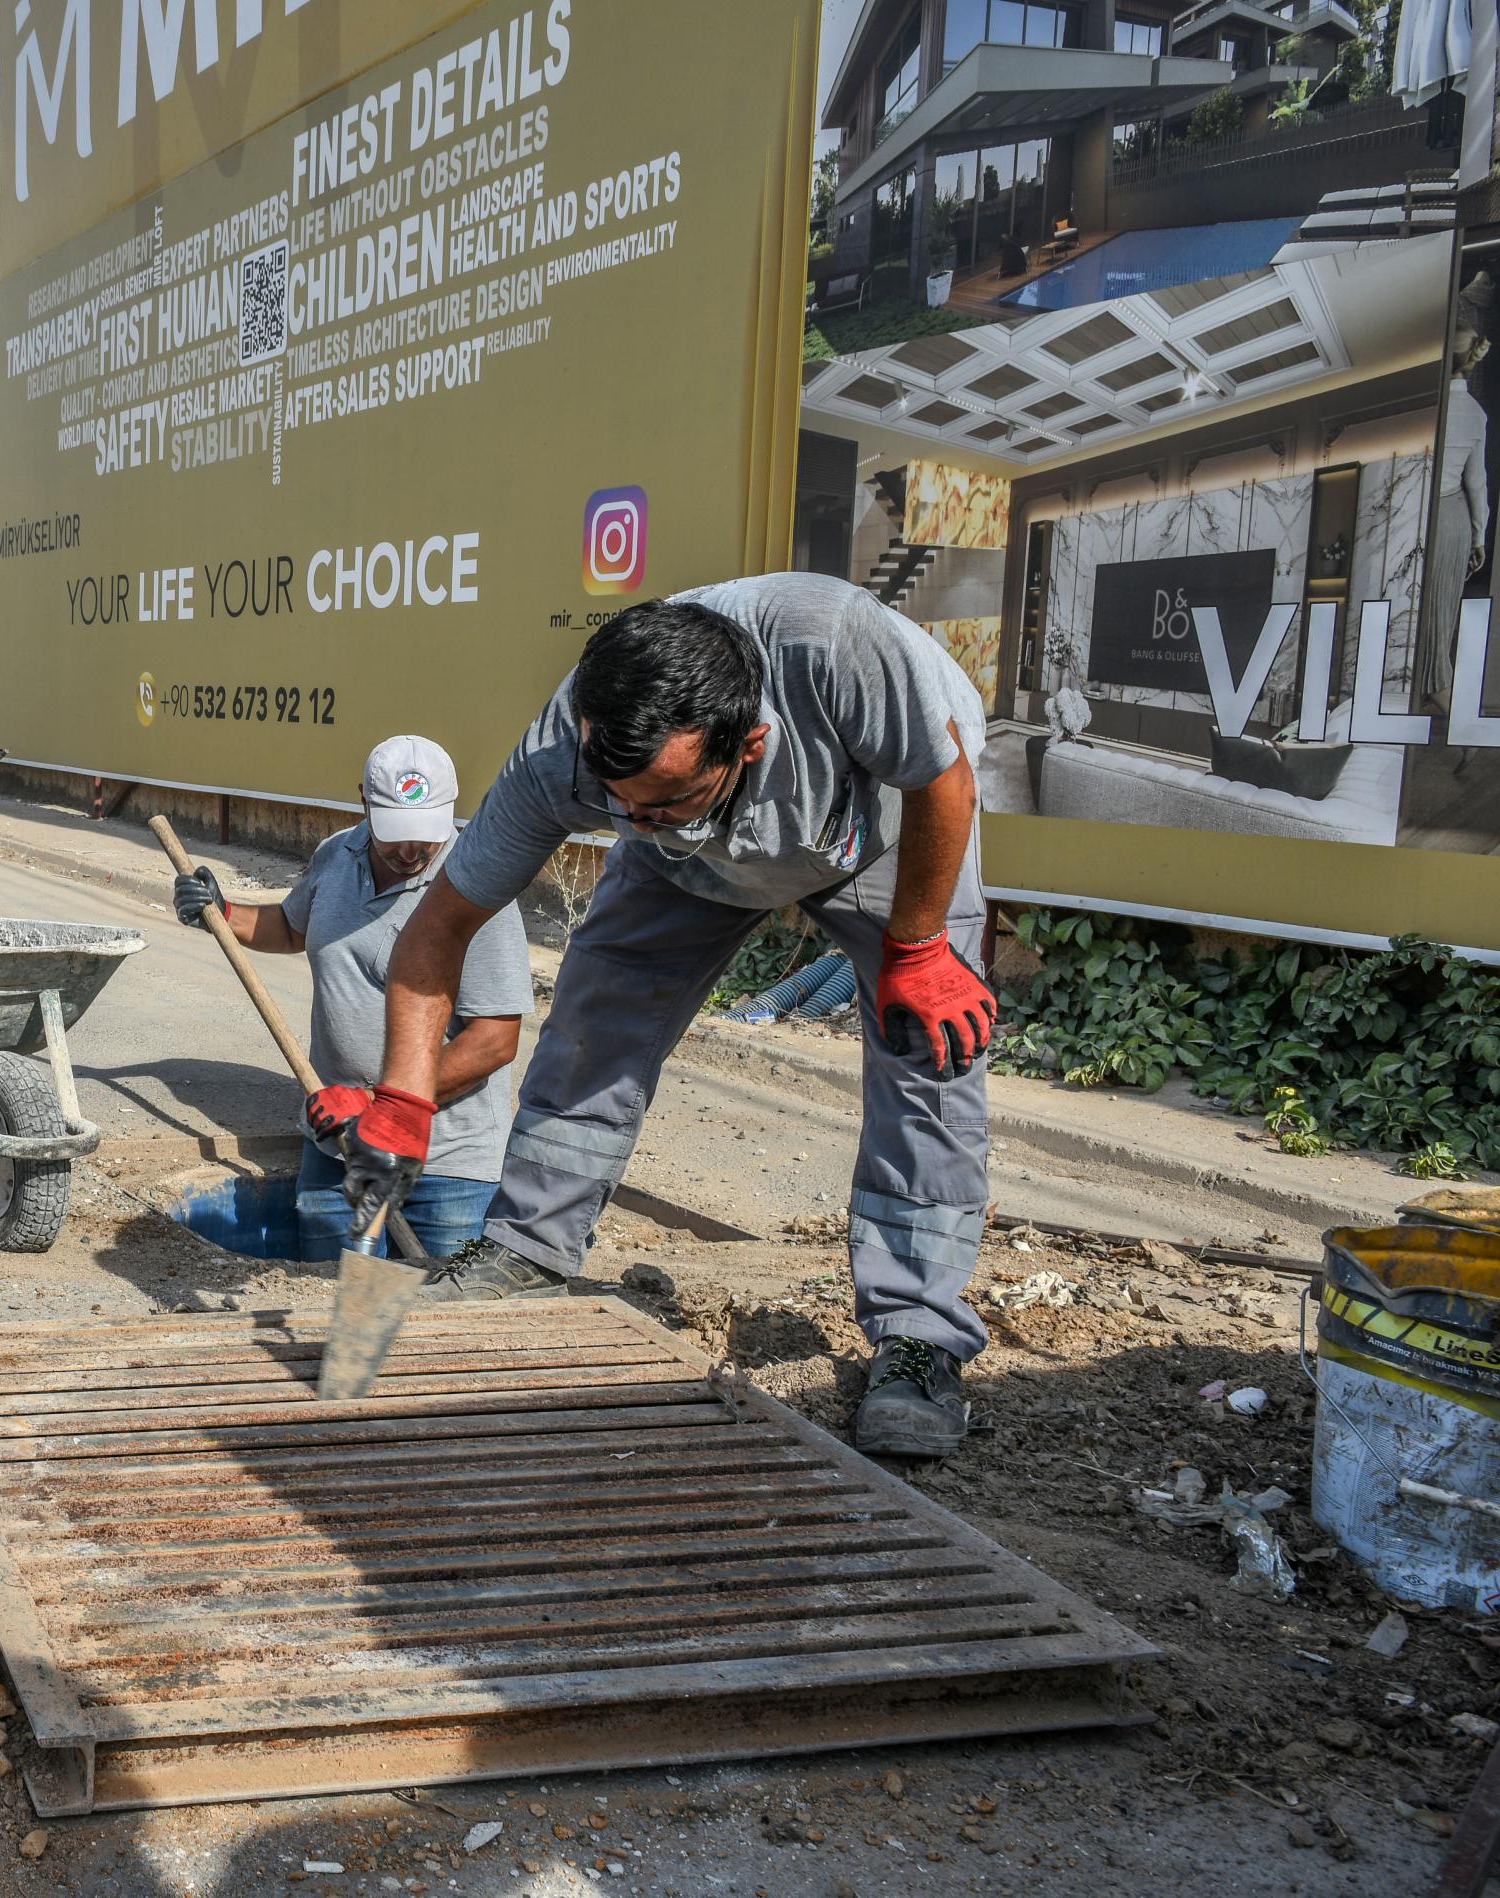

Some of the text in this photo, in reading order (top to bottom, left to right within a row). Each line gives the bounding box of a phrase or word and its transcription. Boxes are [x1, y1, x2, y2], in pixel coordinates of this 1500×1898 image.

[292, 80, 401, 208] FINEST
[410, 0, 572, 151] DETAILS
[291, 105, 549, 256] LIFE WITHOUT OBSTACLES
[450, 151, 681, 278] HEALTH AND SPORTS
[451, 162, 544, 231] LANDSCAPE
[28, 230, 153, 320] RESEARCH AND DEVELOPMENT
[154, 206, 163, 287] MIR LOFT
[162, 190, 289, 286] EXPERT PARTNERS
[288, 204, 446, 336] CHILDREN
[546, 220, 677, 287] ENVIRONMENTALITY
[6, 296, 100, 379] TRANSPARENCY
[100, 283, 123, 310] SOCIAL
[100, 260, 238, 376] FIRST HUMAN
[287, 265, 543, 380] TIMELESS ARCHITECTURE DESIGN
[486, 316, 551, 356] RELIABILITY
[27, 349, 99, 401] DELIVERY ON TIME
[61, 385, 96, 424] QUALITY
[102, 367, 145, 410] CONFORT
[147, 360, 167, 394] AND
[170, 334, 239, 388] AESTHETICS
[171, 364, 274, 428] RESALE MARKET
[284, 336, 485, 430] AFTER-SALES SUPPORT
[58, 420, 96, 451] WORLD MIR
[95, 397, 169, 476] SAFETY
[171, 407, 273, 473] STABILITY
[273, 361, 284, 486] SUSTAINABILITY
[66, 532, 480, 626] YOUR LIFE YOUR CHOICE
[1131, 649, 1155, 660] BANG
[1156, 650, 1163, 660] &
[1190, 597, 1500, 746] VILL
[161, 686, 335, 725] +90 532 673 92 12
